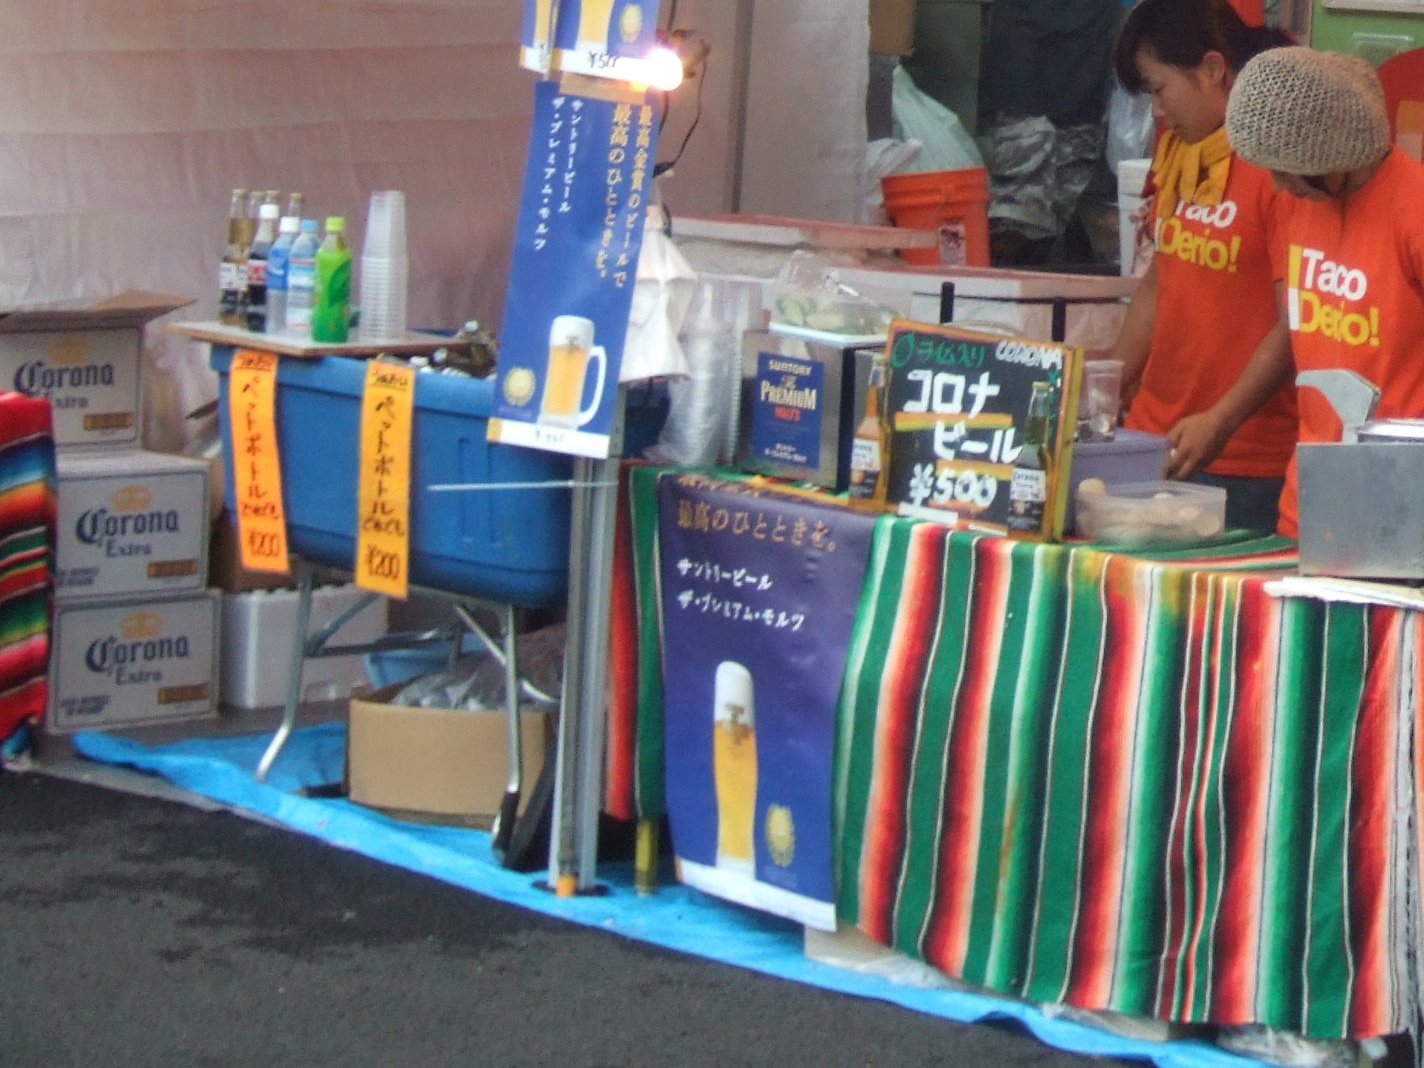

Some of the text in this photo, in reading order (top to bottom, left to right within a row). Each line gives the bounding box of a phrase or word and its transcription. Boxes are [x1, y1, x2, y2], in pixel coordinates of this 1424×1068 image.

[1301, 248, 1368, 302] Taco
[995, 339, 1064, 371] CORONA
[13, 359, 115, 398] Corona
[903, 369, 1001, 420] コロナ
[933, 419, 1024, 464] ビール
[909, 463, 998, 508] ¥500
[75, 506, 180, 547] Corona
[85, 635, 190, 677] Corona
